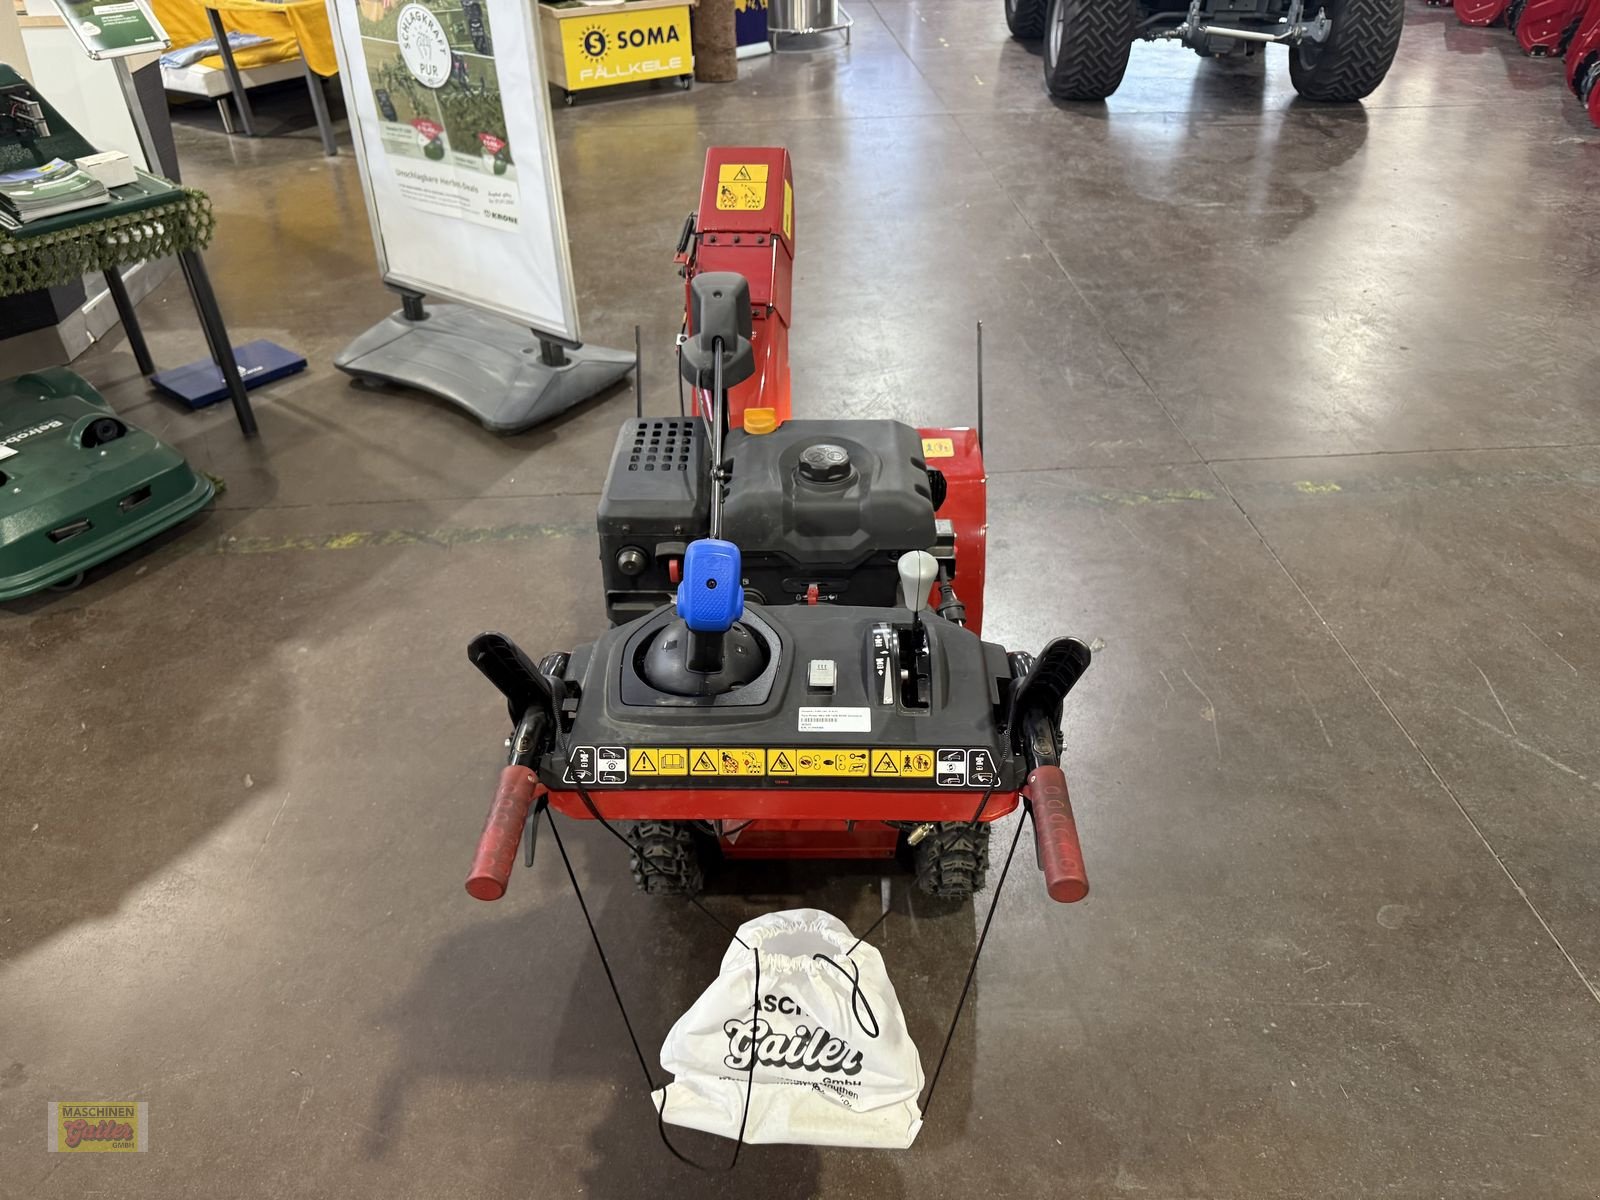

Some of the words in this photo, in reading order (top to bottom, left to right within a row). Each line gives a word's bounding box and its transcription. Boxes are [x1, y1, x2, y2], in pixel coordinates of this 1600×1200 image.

[401, 11, 447, 56] SCHLAGKRAFT
[617, 25, 680, 49] SOMA
[420, 63, 439, 77] PUR
[723, 1018, 864, 1076] Gailer
